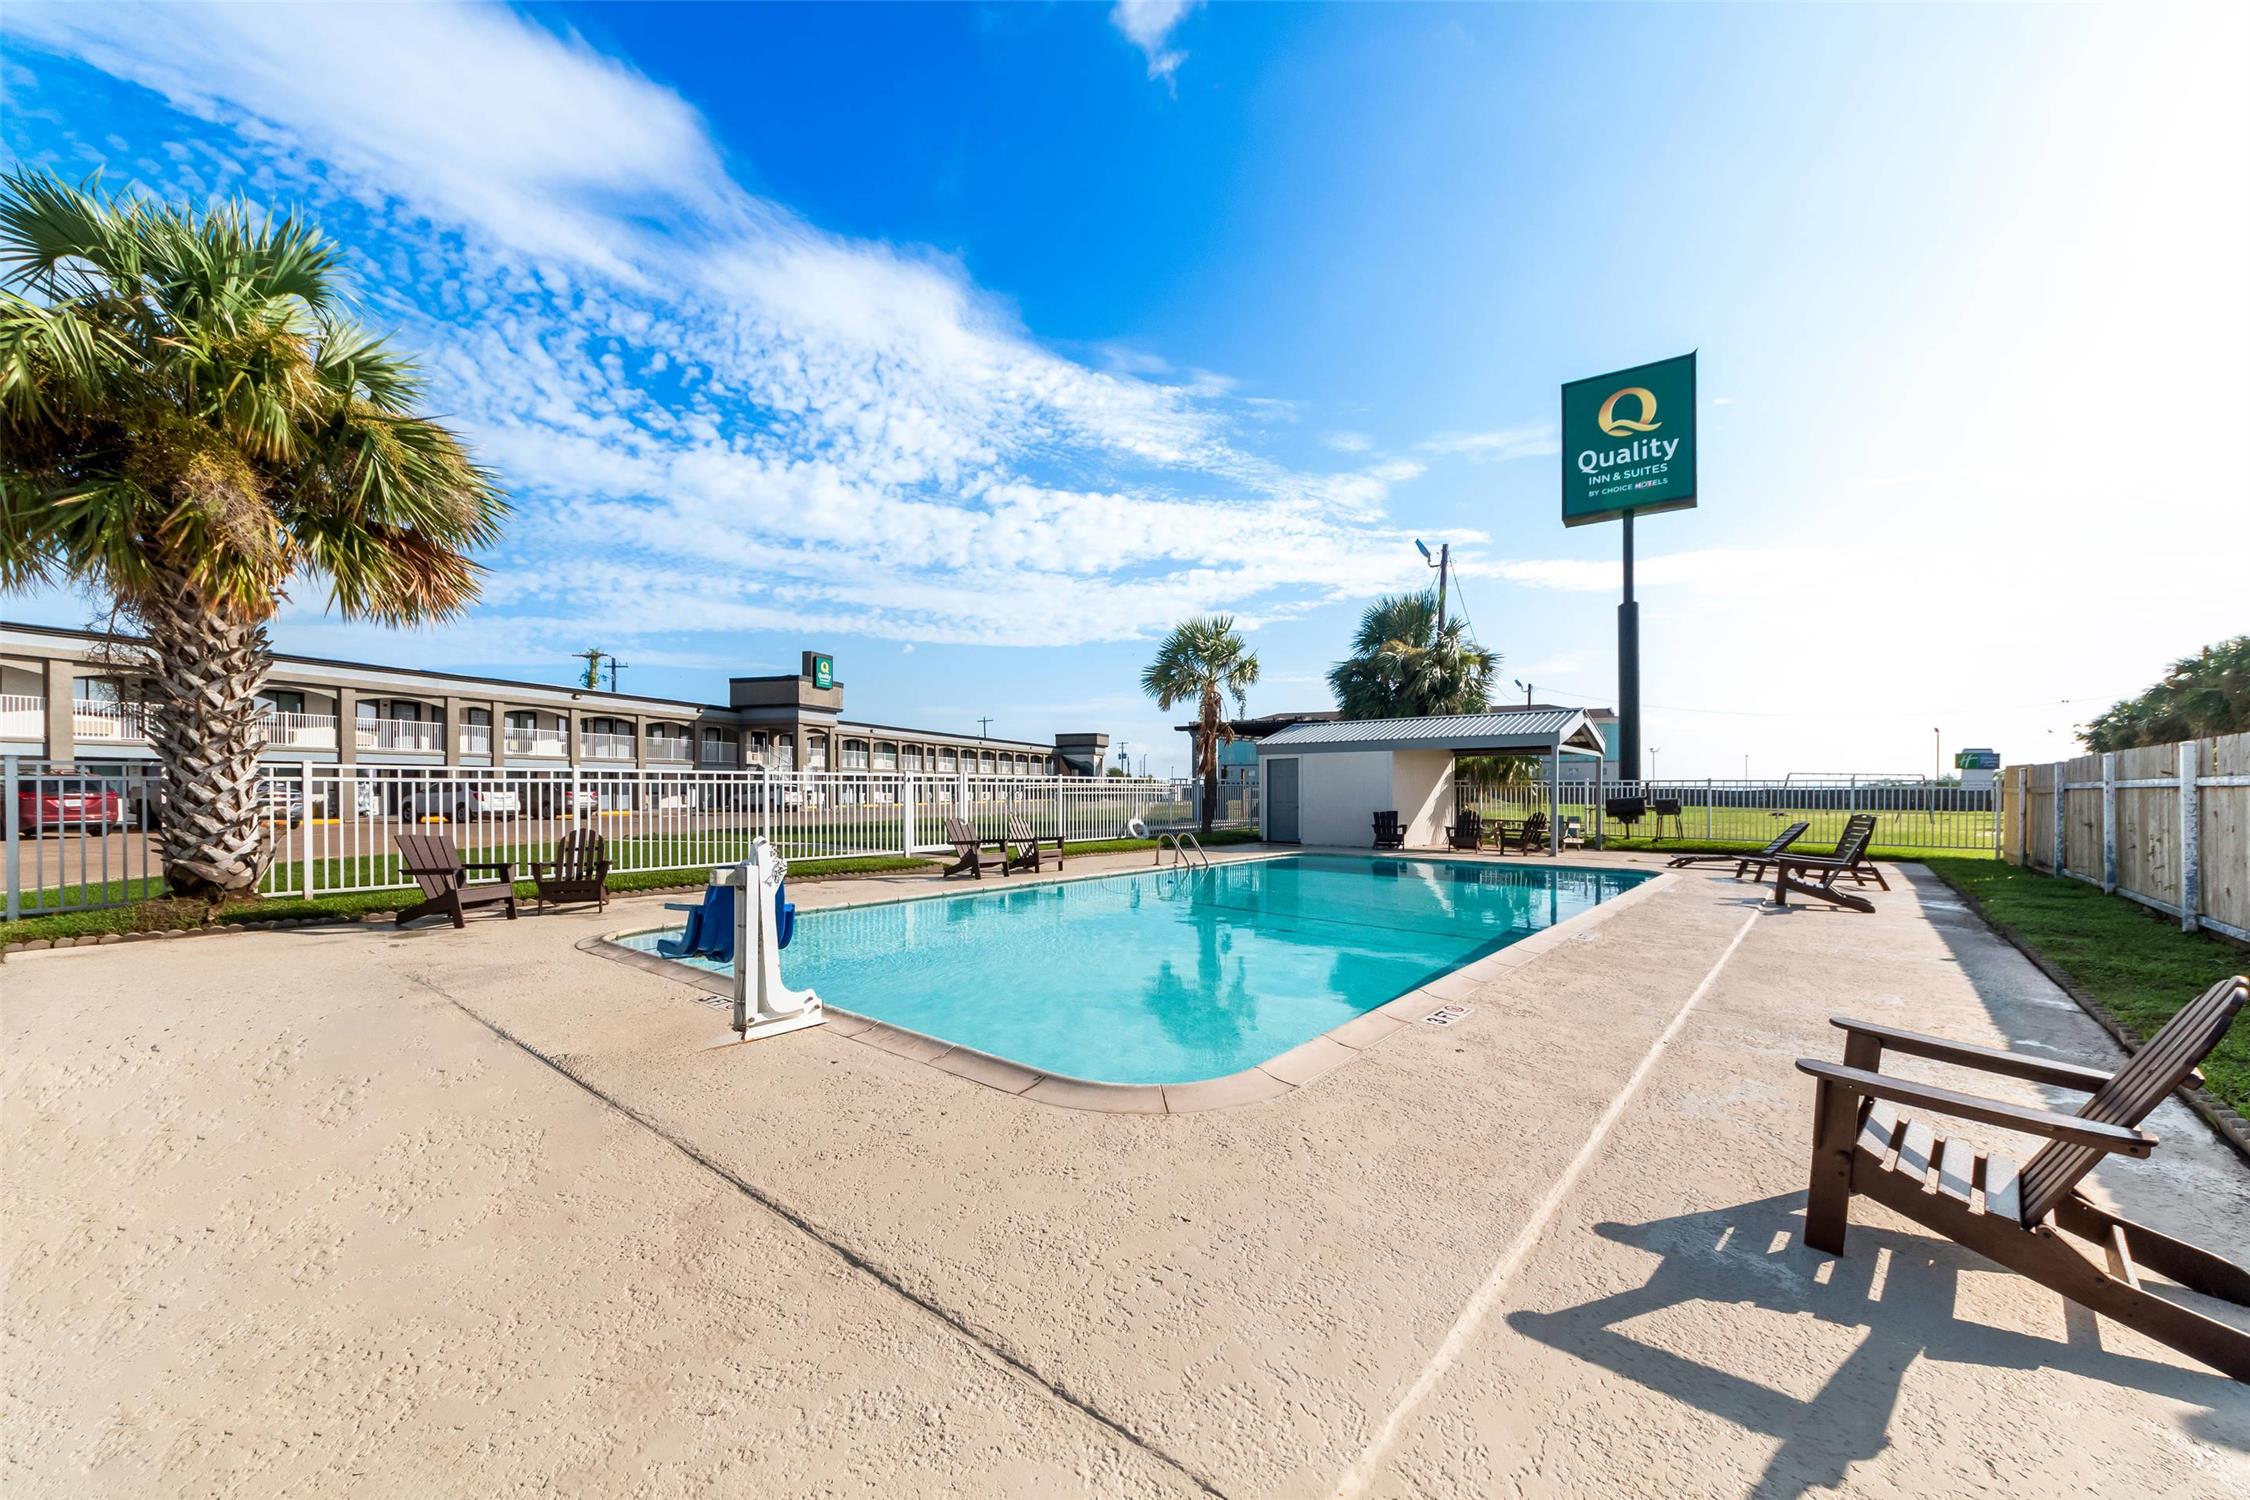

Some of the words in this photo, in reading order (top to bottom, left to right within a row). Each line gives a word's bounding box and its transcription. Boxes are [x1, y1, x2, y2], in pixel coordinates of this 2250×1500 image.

[1598, 387, 1662, 437] Q
[1577, 437, 1680, 474] Quality
[1588, 473, 1611, 486] INN
[1612, 471, 1622, 481] &
[1623, 463, 1668, 479] SUITES
[1588, 489, 1600, 497] BY
[1601, 483, 1633, 495] CHOICE
[1634, 477, 1669, 489] HOTELS
[1426, 1017, 1448, 1025] 3
[1434, 1010, 1460, 1021] FT
